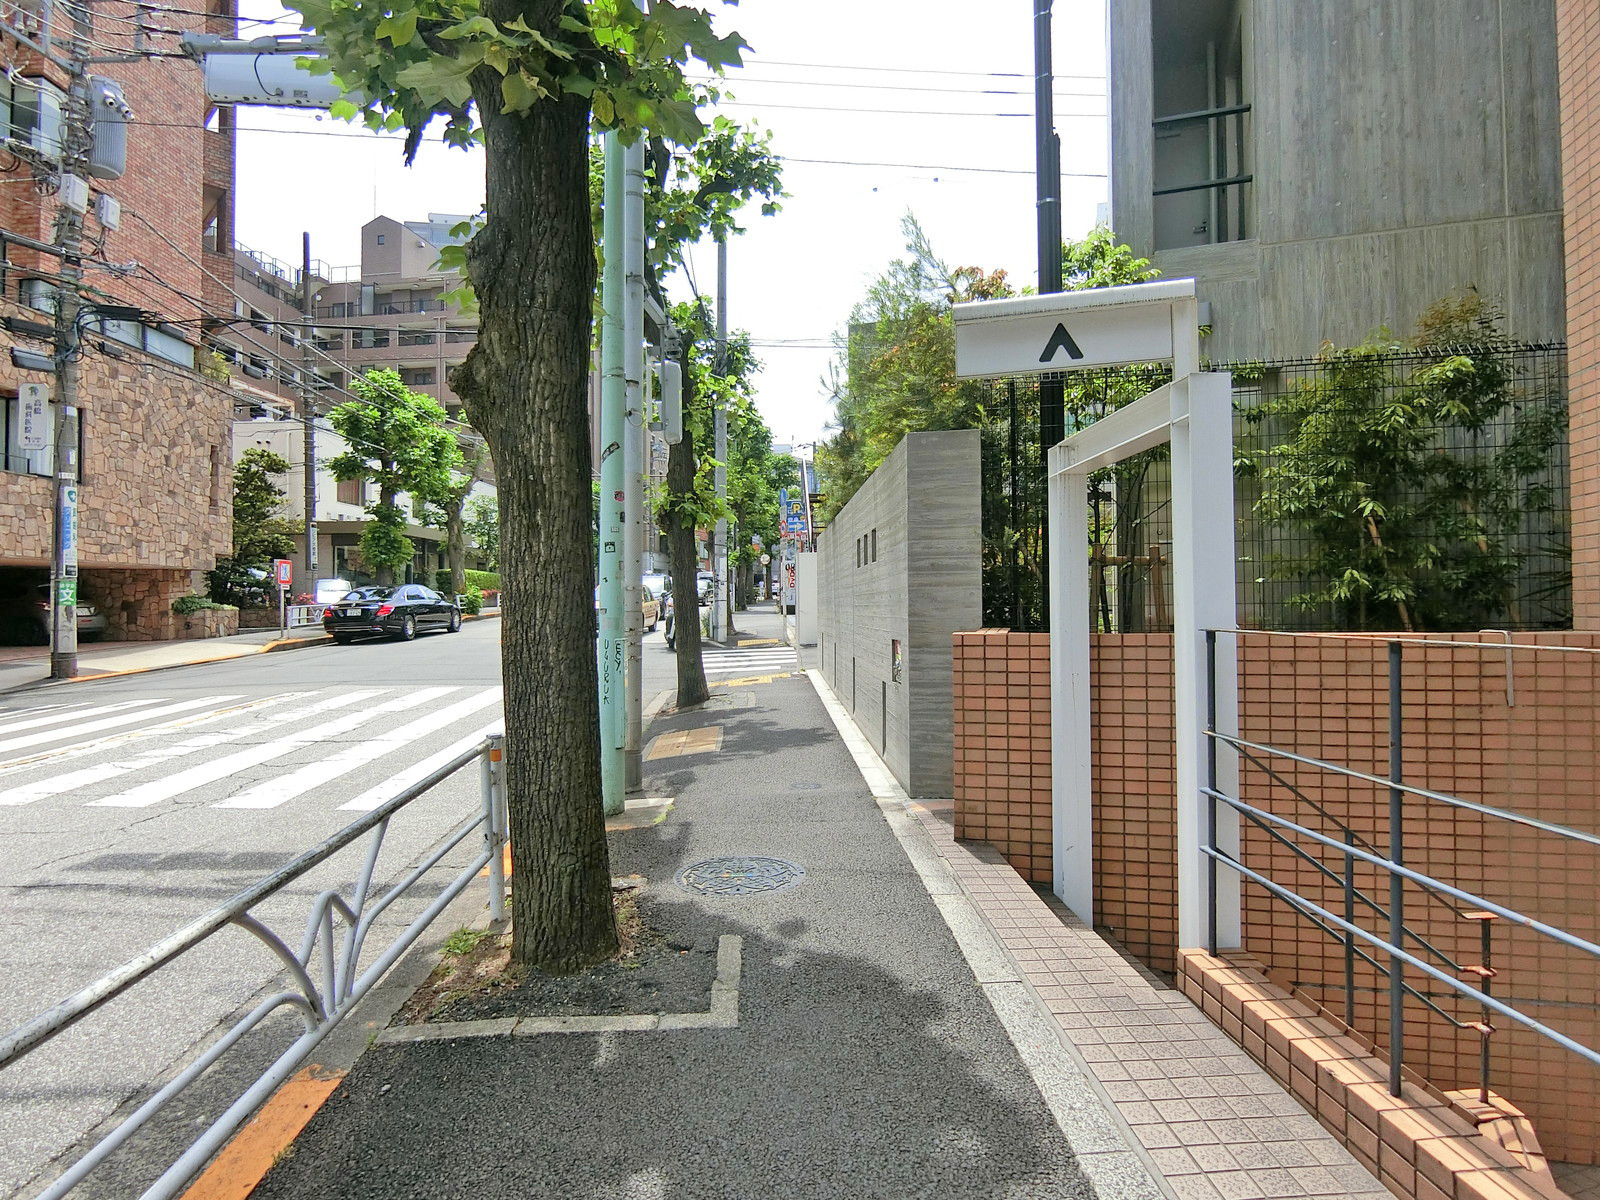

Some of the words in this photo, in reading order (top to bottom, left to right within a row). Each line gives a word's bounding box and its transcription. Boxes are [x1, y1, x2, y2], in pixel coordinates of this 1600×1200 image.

[24, 402, 33, 434] 歯科医院
[59, 588, 75, 602] 文
